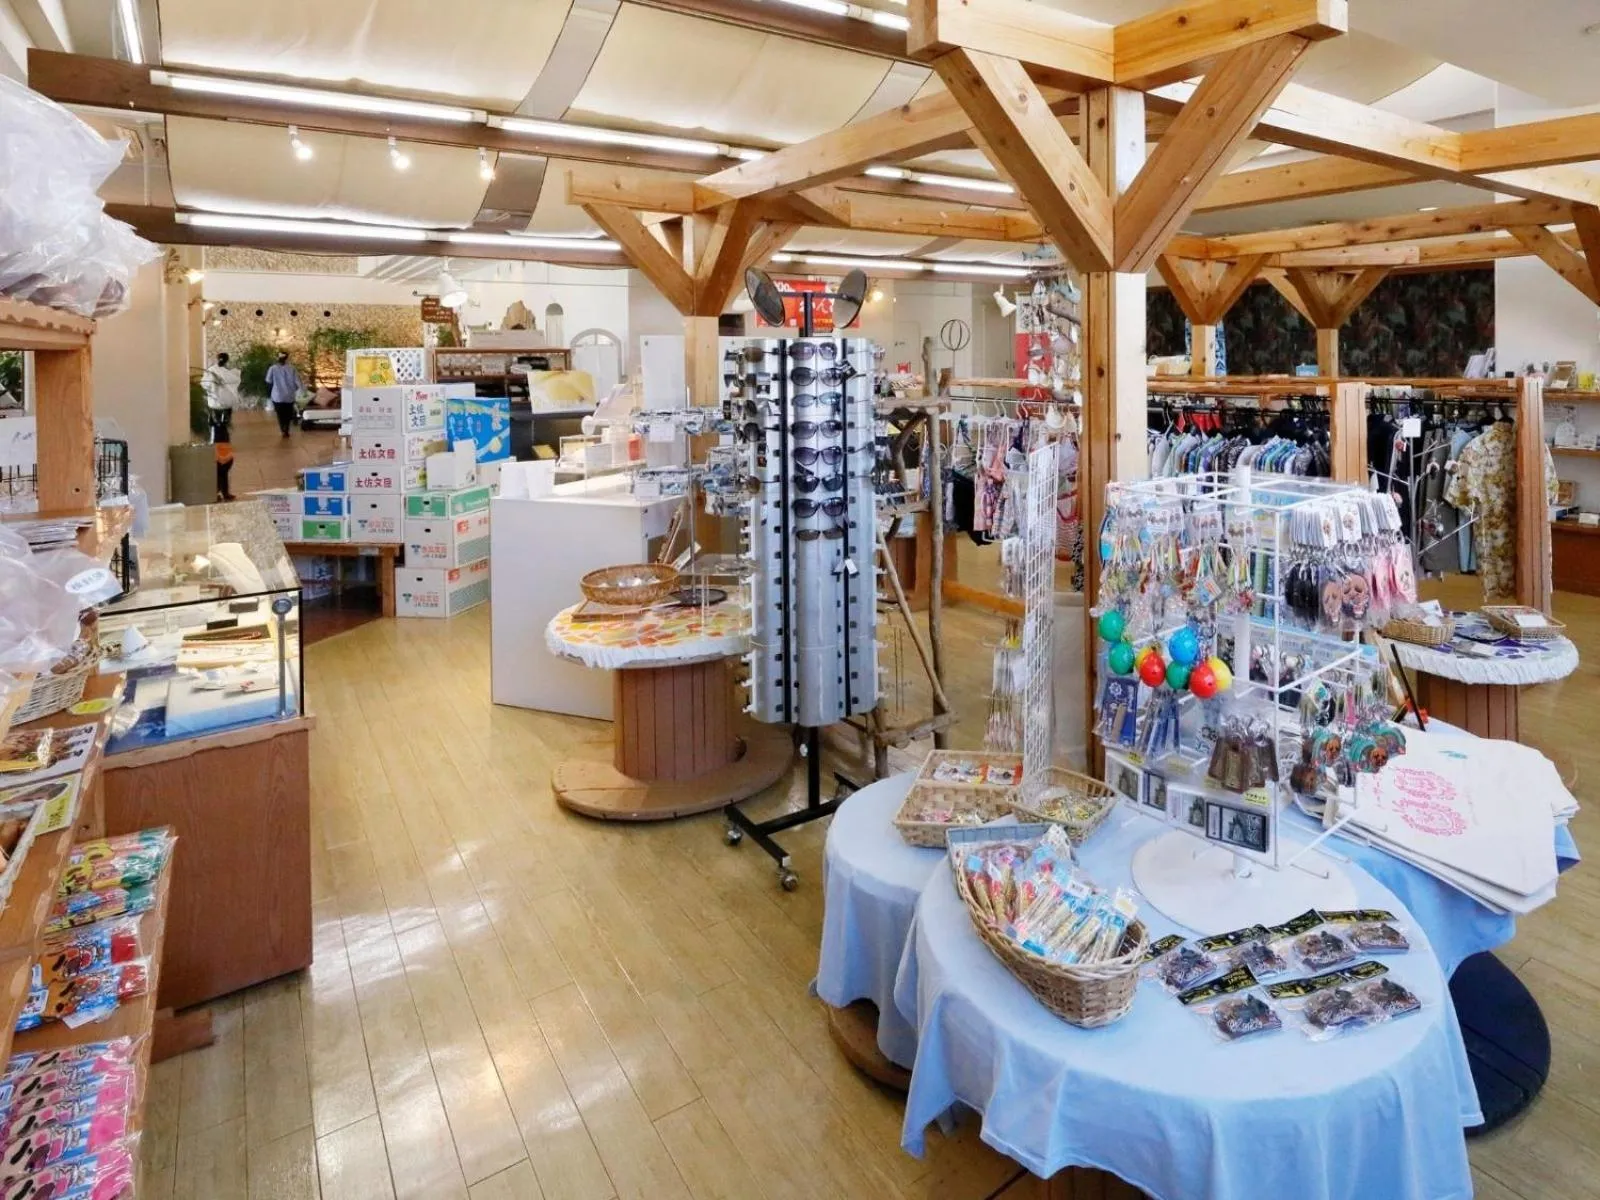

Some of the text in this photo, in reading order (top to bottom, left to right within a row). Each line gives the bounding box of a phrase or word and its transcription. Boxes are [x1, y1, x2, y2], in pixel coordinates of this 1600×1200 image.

[359, 448, 396, 460] 土佐文旦
[355, 477, 393, 489] 土佐文旦
